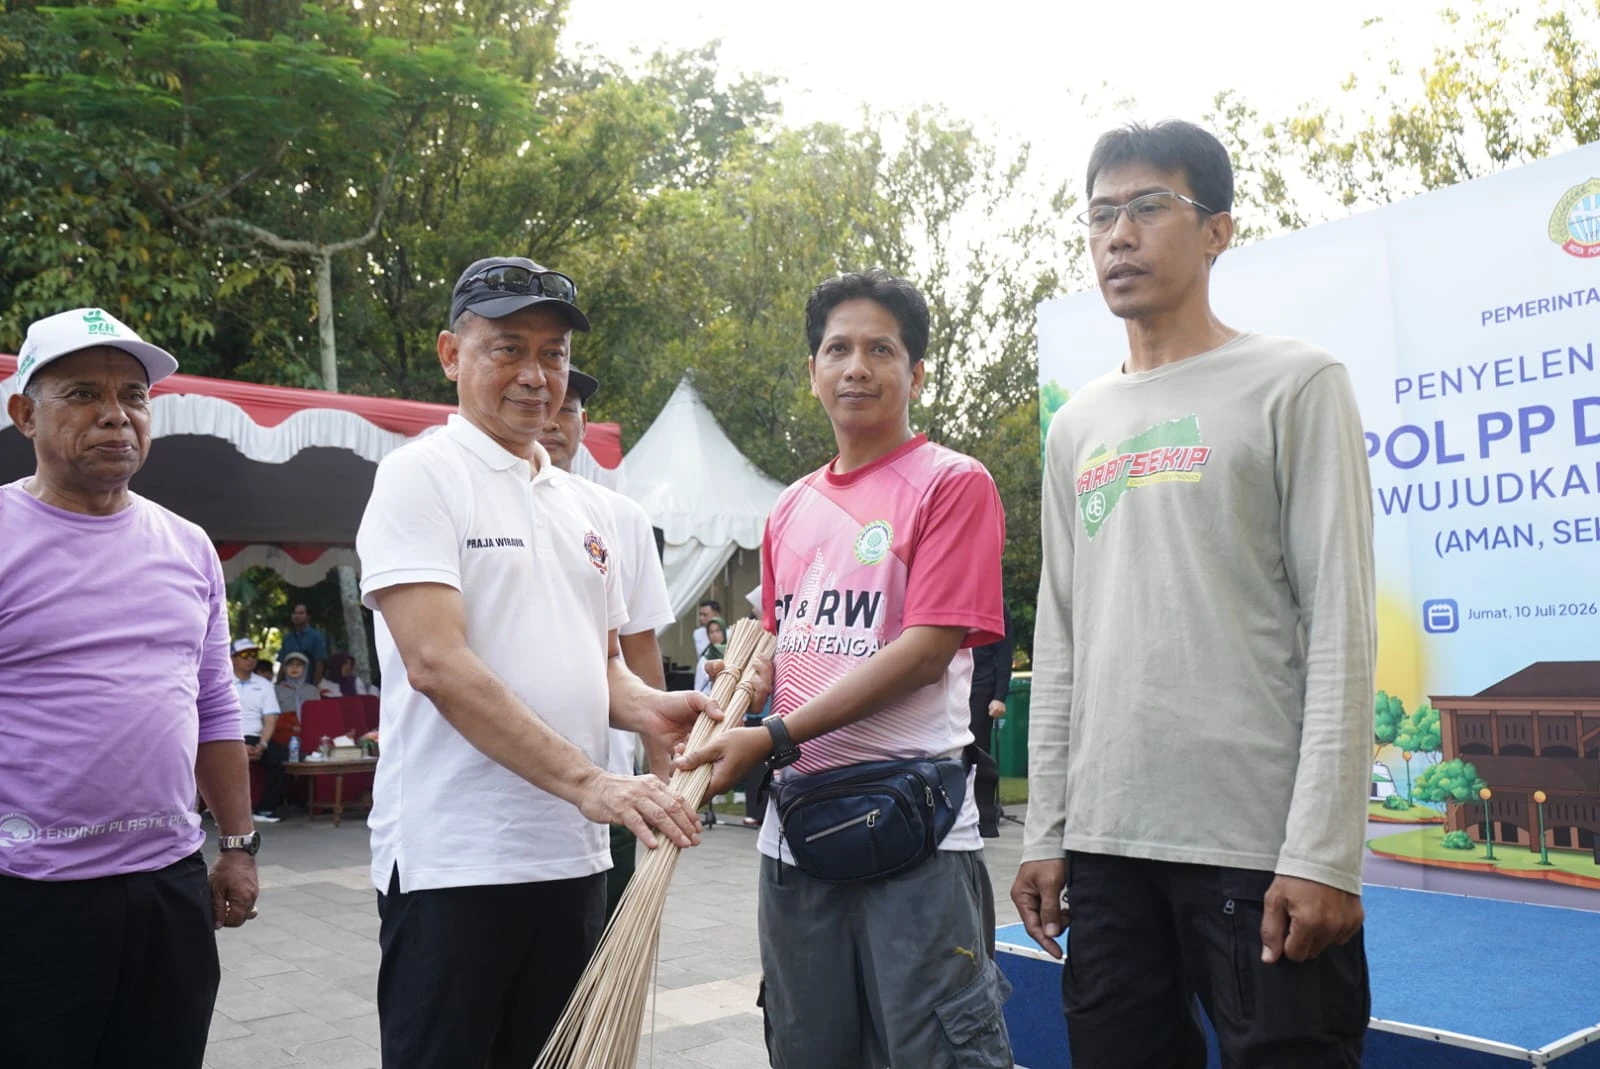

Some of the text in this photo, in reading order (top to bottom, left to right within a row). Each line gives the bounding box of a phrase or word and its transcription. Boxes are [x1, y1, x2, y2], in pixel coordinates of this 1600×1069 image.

[88, 323, 115, 332] DLH
[1395, 343, 1594, 404] PENYELEN
[1477, 405, 1556, 459] PP
[1076, 453, 1132, 496] ARAT
[1128, 446, 1212, 477] SEKIP
[1377, 461, 1600, 516] WUJUDKA
[466, 537, 494, 549] PRAJA
[1435, 517, 1600, 559] (AMAN, SE
[796, 600, 808, 618] &
[815, 589, 882, 629] RW
[1468, 602, 1598, 620] Jumat, 10 Juli 2026
[108, 816, 164, 833] PLASTIC
